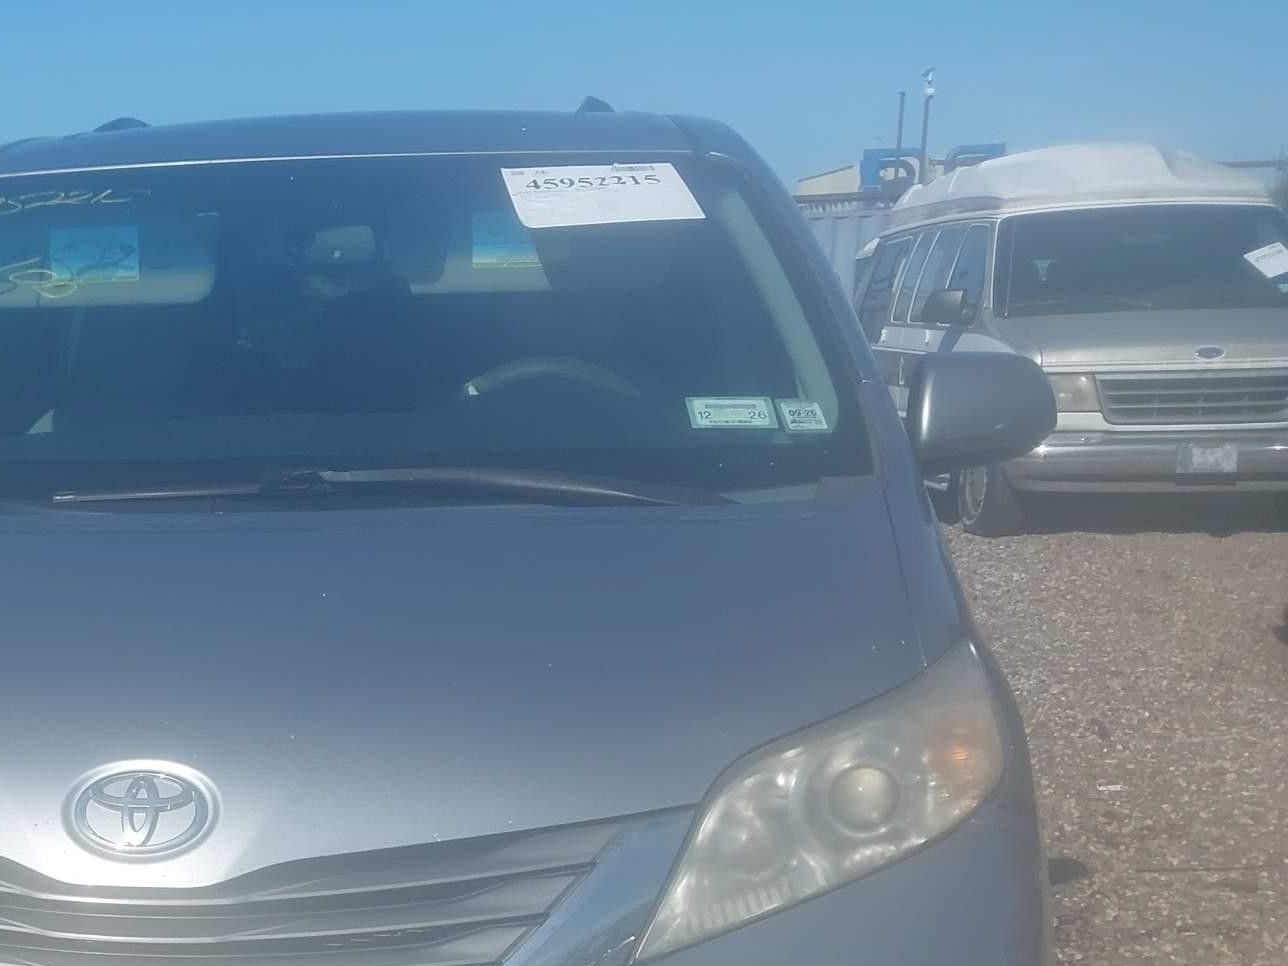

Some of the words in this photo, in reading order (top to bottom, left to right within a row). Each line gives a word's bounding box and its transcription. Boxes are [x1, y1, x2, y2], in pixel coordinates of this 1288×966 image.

[525, 173, 661, 190] 45952215
[697, 410, 712, 420] 12
[747, 410, 768, 420] 26
